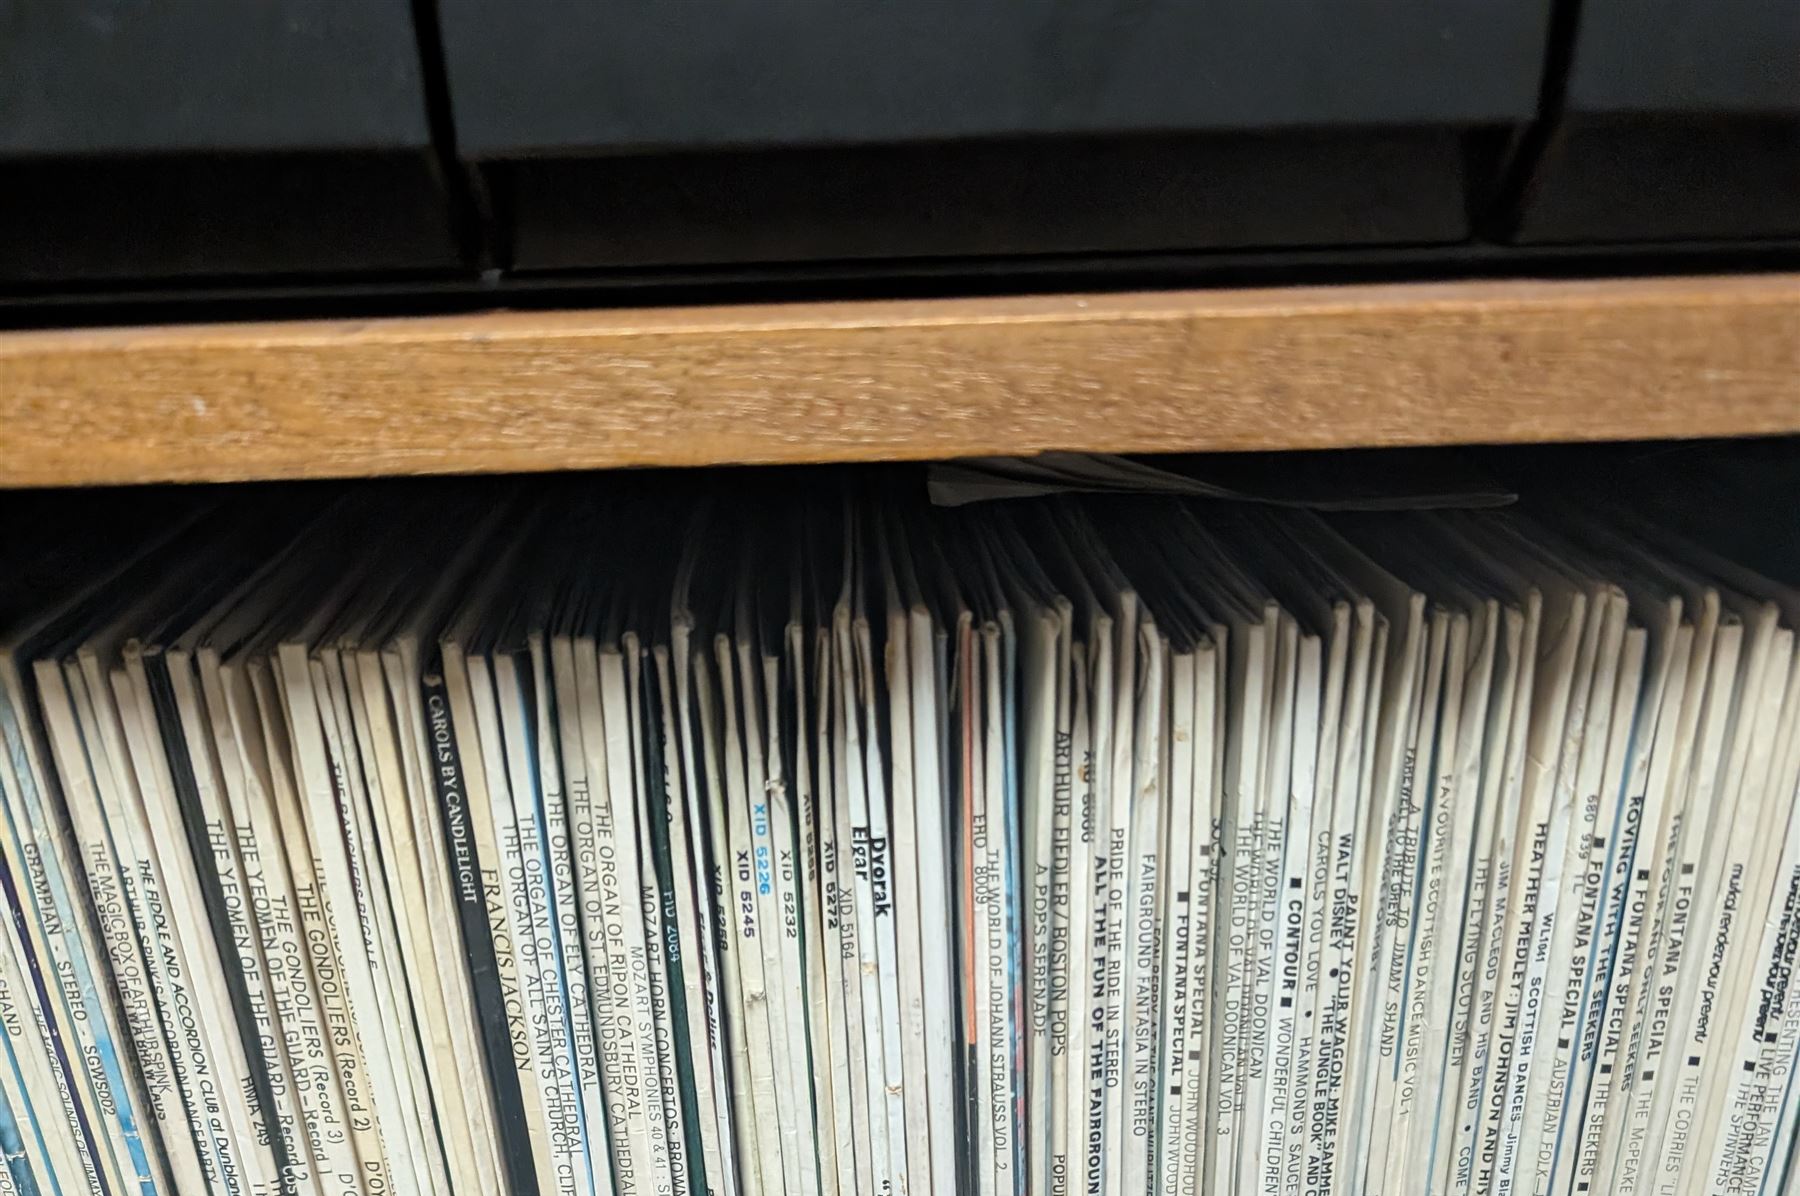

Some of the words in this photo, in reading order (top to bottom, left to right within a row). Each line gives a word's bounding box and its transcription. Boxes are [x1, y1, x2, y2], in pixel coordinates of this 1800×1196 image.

[426, 695, 453, 762] CAROLS
[439, 766, 457, 786] BY
[592, 800, 612, 838] THE
[752, 803, 766, 836] XID
[136, 859, 155, 885] THE
[444, 791, 478, 903] CANDLELIGHT
[736, 850, 750, 881] XID
[755, 846, 770, 896] 5226
[779, 850, 792, 881] XID
[849, 826, 870, 881] Elgar
[1333, 833, 1352, 880] WALT
[596, 845, 621, 915] ORGAN
[869, 836, 891, 918] Dvorak
[1093, 855, 1107, 895] ALL
[144, 889, 170, 940] FIDDLE
[296, 883, 320, 921] THE
[739, 890, 754, 938] 5245
[782, 891, 796, 938] 5232
[1092, 904, 1107, 947] THE
[1136, 854, 1156, 968] FAIRGROUND
[1326, 887, 1347, 950] DISNEY
[606, 923, 624, 947] OF
[1281, 899, 1303, 990] CONTOUR
[1533, 912, 1554, 962] WL1041
[1660, 886, 1693, 974] FONTANA
[18, 842, 64, 935] GRAMPIAN
[55, 961, 88, 1021] STEREO
[82, 1045, 117, 1116] SGWS002
[159, 944, 181, 978] AND
[480, 868, 514, 967] FRANCIS
[499, 973, 532, 1071] JACKSON
[609, 953, 630, 1008] RIPON
[1091, 956, 1105, 998] FUN
[307, 929, 350, 1046] GONDOLIERS
[170, 982, 208, 1075] ACCORDION
[1090, 1007, 1104, 1032] OF
[1133, 976, 1151, 1053] FANTASIA
[1517, 977, 1543, 1055] SCOTTISH
[1644, 986, 1674, 1060] SPECIAL
[336, 1052, 366, 1112] (Record
[615, 1015, 642, 1120] CATHEDRAL
[1090, 1040, 1103, 1080] THE
[1134, 1058, 1148, 1074] IN
[1269, 1017, 1292, 1114] WONDERFUL
[1312, 1039, 1332, 1097] JUNGLE
[198, 1079, 219, 1113] CLUB
[1132, 1080, 1147, 1136] STEREO
[1633, 1089, 1653, 1118] THE
[1678, 1076, 1699, 1104] THE
[1760, 1084, 1784, 1113] THE
[209, 1117, 223, 1132] at
[350, 1116, 372, 1132] 2)
[1662, 1109, 1692, 1172] CORRIES
[1752, 1121, 1774, 1147] IAN
[1304, 1155, 1320, 1185] AND
[1617, 1128, 1644, 1193] McPEAKE
